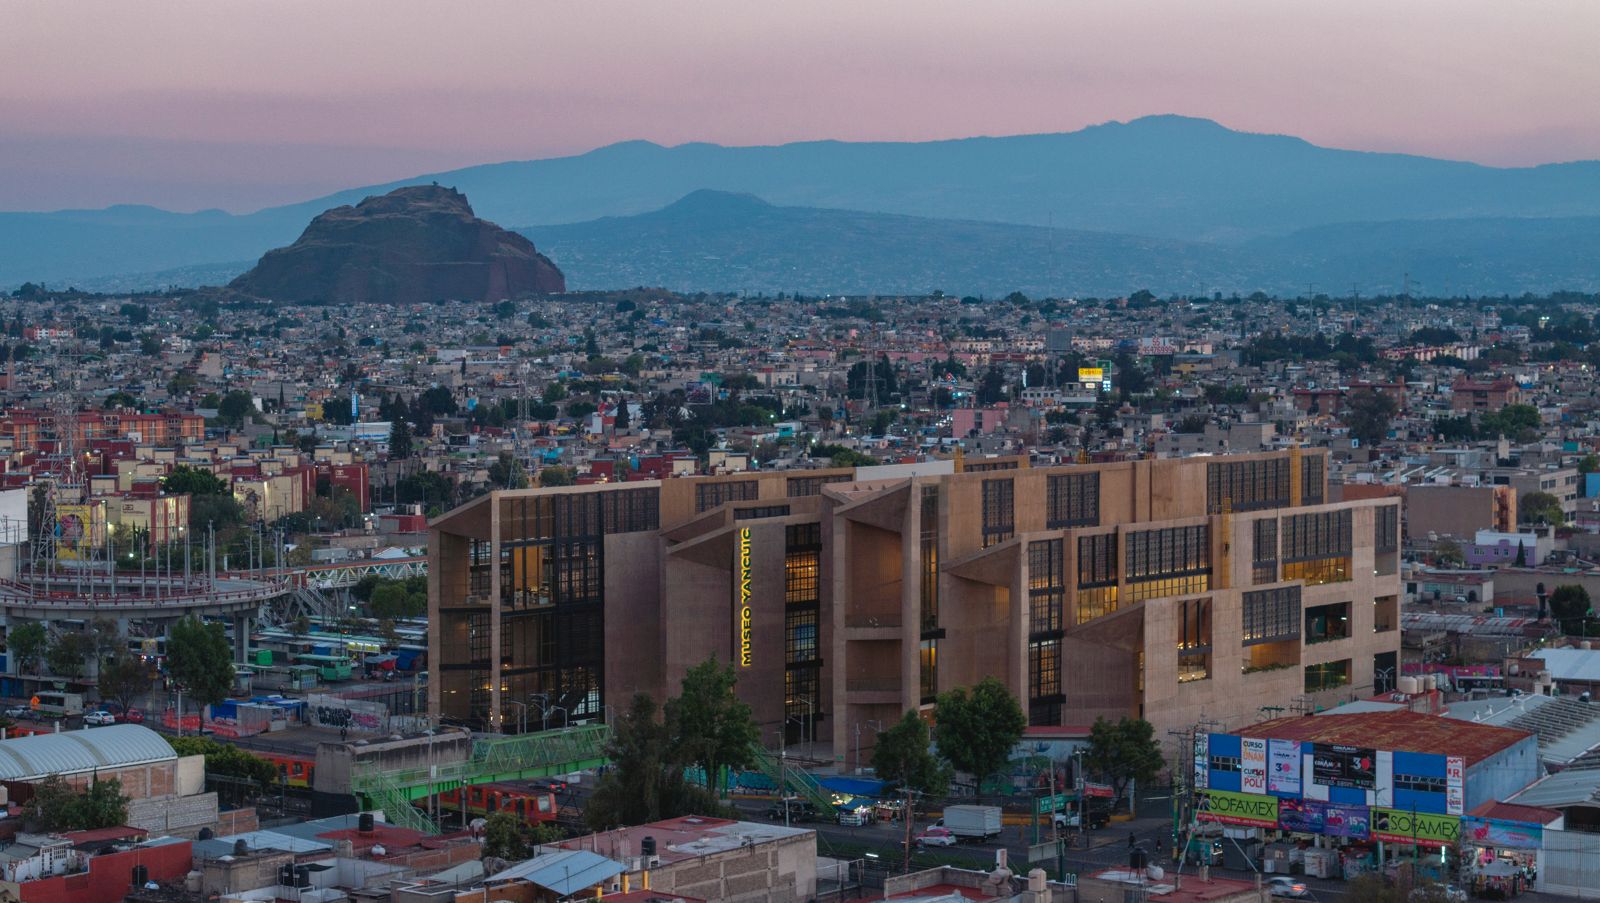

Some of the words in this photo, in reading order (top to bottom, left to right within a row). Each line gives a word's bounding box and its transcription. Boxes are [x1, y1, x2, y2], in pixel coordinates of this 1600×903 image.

[740, 527, 751, 604] YANCUIC
[741, 606, 751, 666] MUSEO
[1243, 740, 1263, 749] CURSO
[1211, 795, 1273, 817] SOFAMEX
[1391, 815, 1459, 838] SOFAMEX
